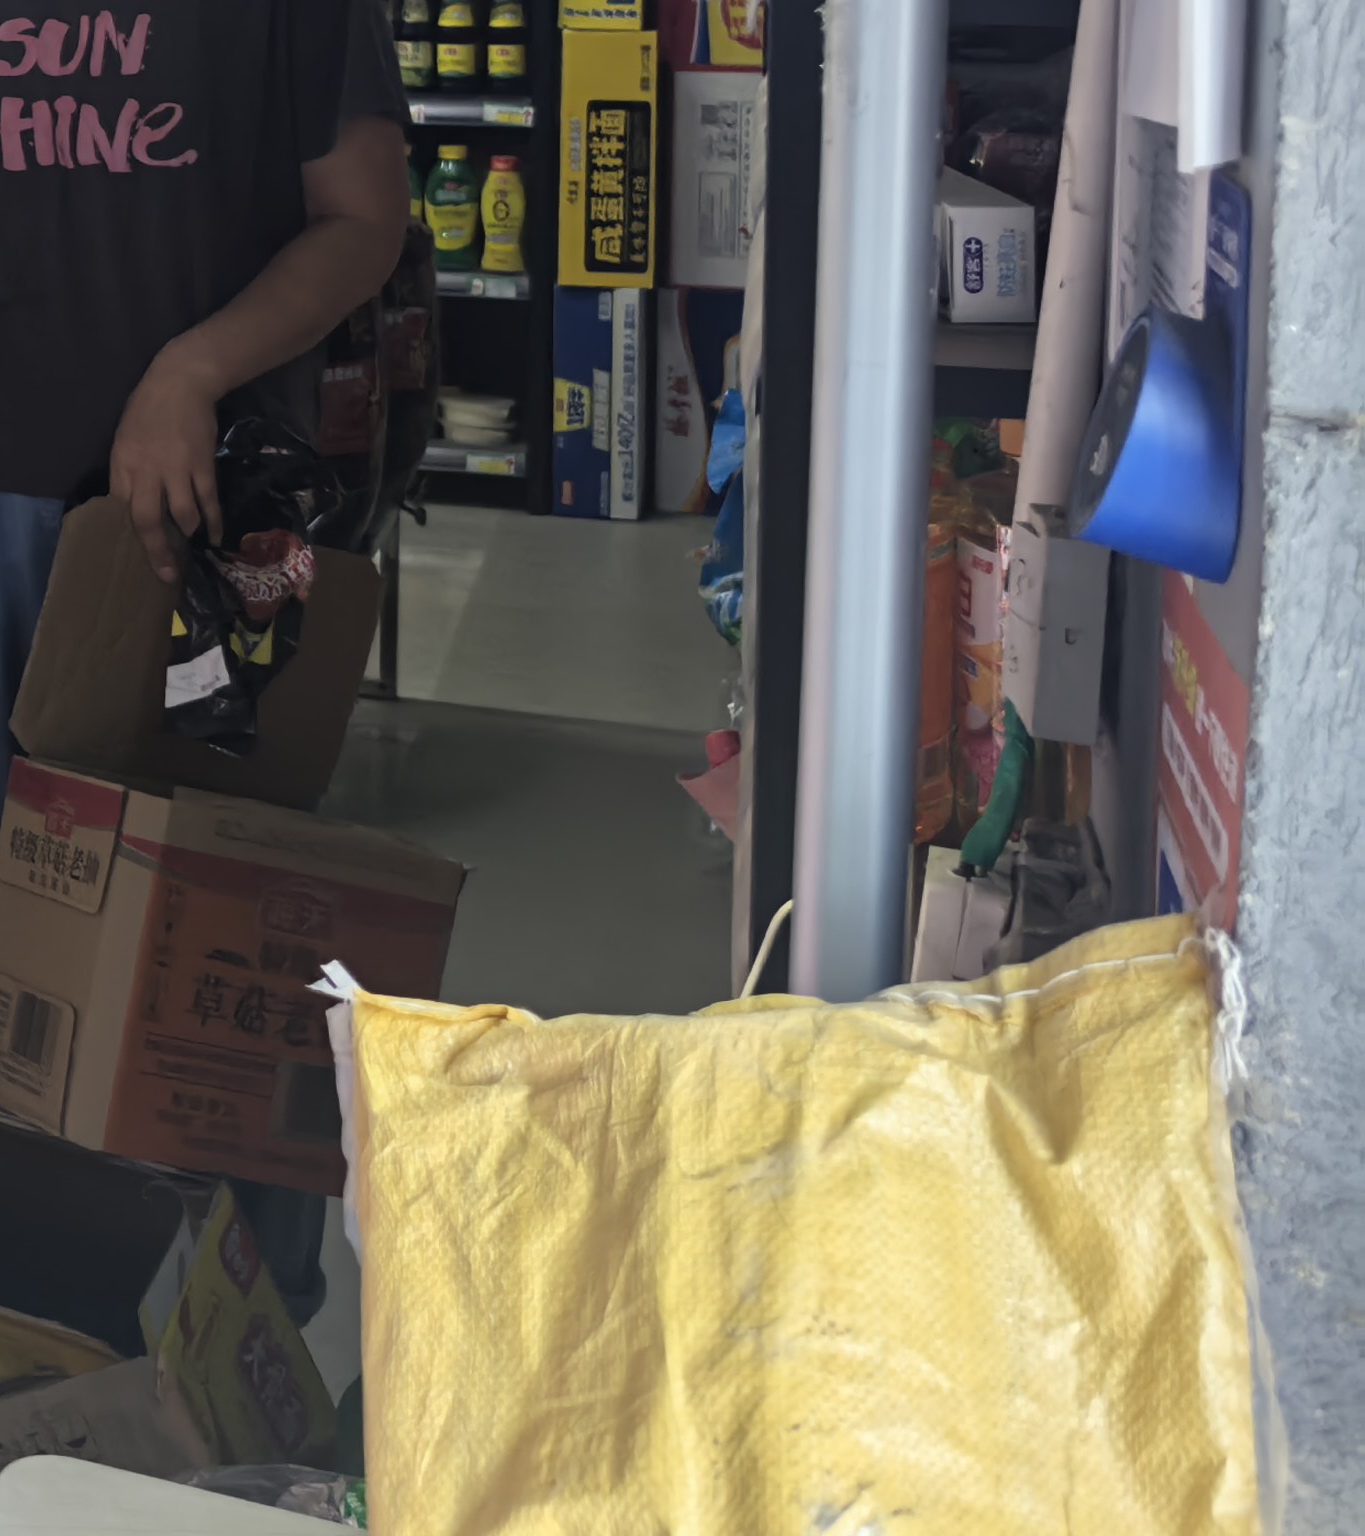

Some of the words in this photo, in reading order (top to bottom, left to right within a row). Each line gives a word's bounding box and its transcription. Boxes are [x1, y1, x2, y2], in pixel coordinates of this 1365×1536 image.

[589, 109, 626, 263] 咸蛋黄拌面
